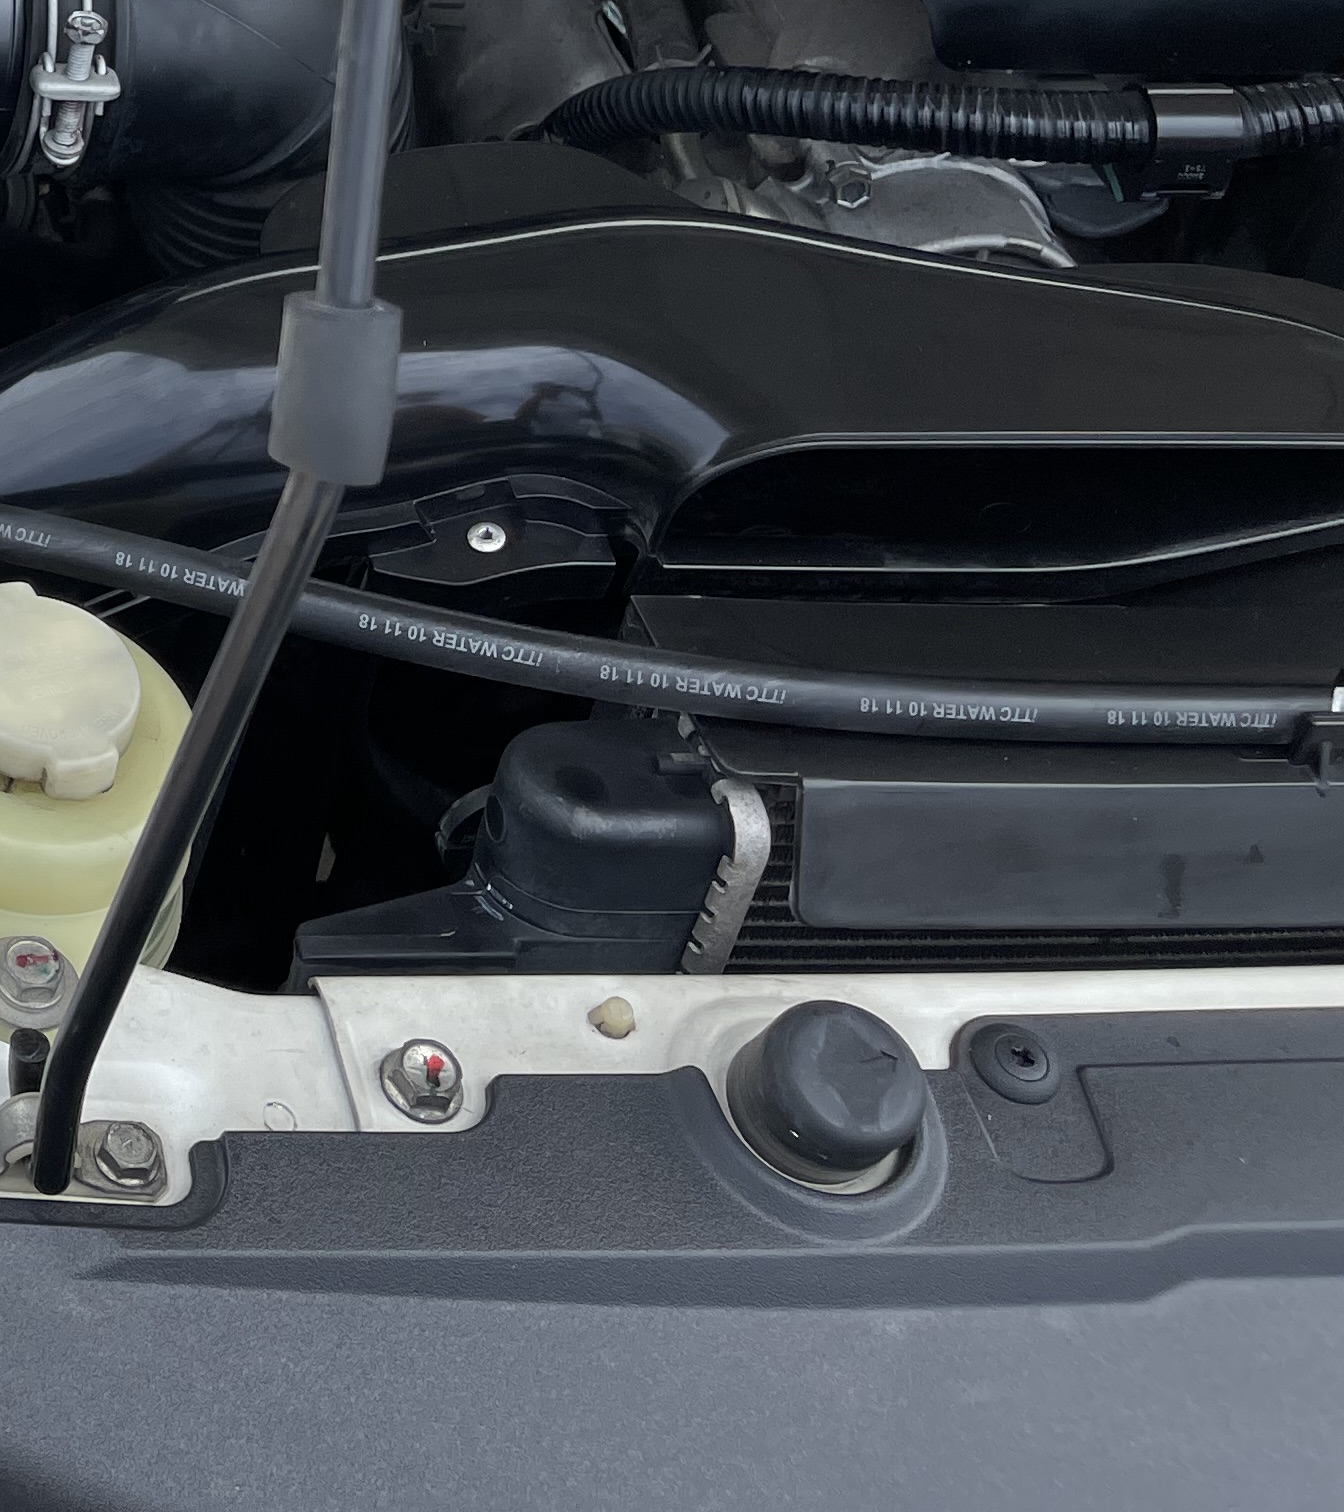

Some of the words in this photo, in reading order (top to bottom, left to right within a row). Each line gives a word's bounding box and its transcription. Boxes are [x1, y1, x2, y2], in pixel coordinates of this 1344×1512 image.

[115, 551, 133, 568] 18
[138, 557, 155, 573] 11
[160, 563, 178, 579] 10
[183, 568, 245, 597] WATER
[358, 613, 377, 630] 18
[384, 619, 402, 636] 11
[407, 625, 427, 643] 10
[432, 629, 498, 659] WATER
[599, 664, 619, 681] 18
[626, 668, 644, 685] 11
[650, 672, 669, 688] 10
[675, 675, 742, 699] WATER
[860, 697, 879, 713] 18
[886, 699, 903, 714] 11
[908, 701, 927, 717] 10
[932, 702, 996, 721] WATER
[1107, 709, 1125, 725] 18
[1131, 710, 1147, 725] 11
[1153, 711, 1171, 726] 10
[1176, 711, 1237, 727] WATER
